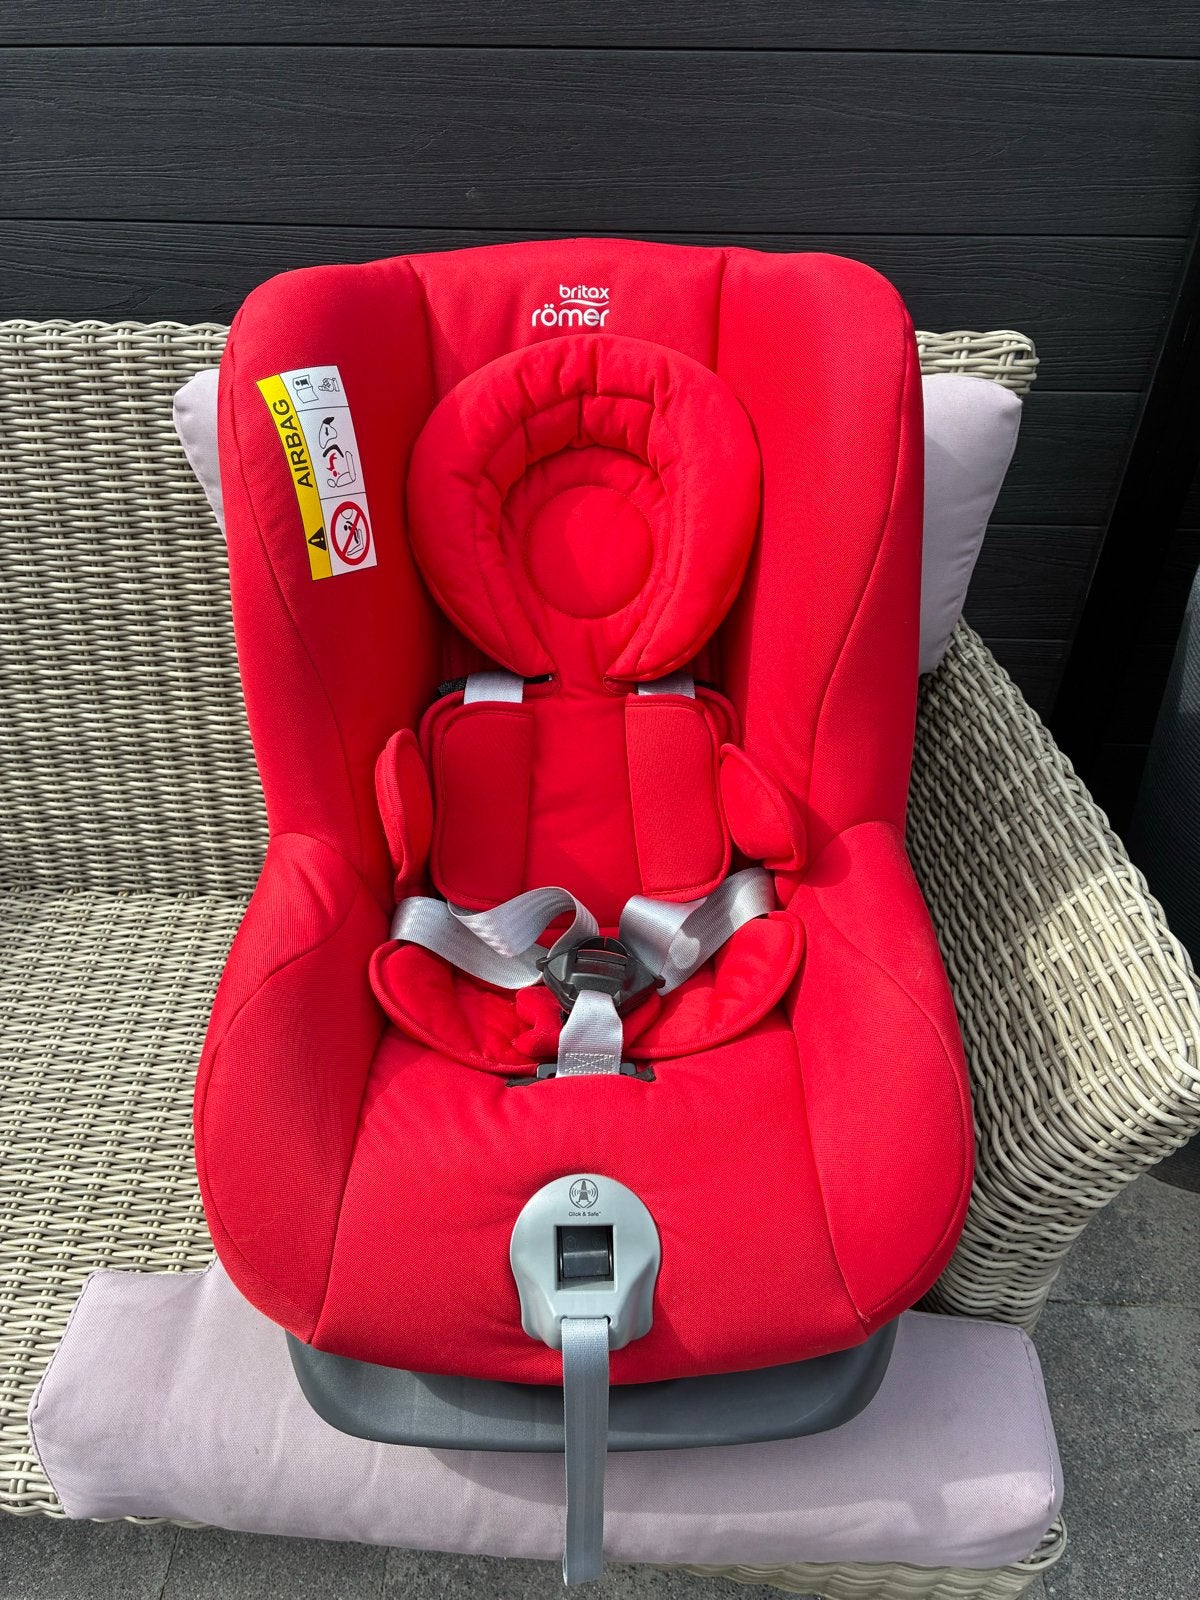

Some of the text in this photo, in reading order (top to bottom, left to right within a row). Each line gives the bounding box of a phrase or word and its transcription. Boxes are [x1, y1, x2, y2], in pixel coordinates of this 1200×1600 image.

[559, 284, 609, 299] britax
[531, 303, 610, 327] römer
[272, 399, 313, 488] AIRBAG
